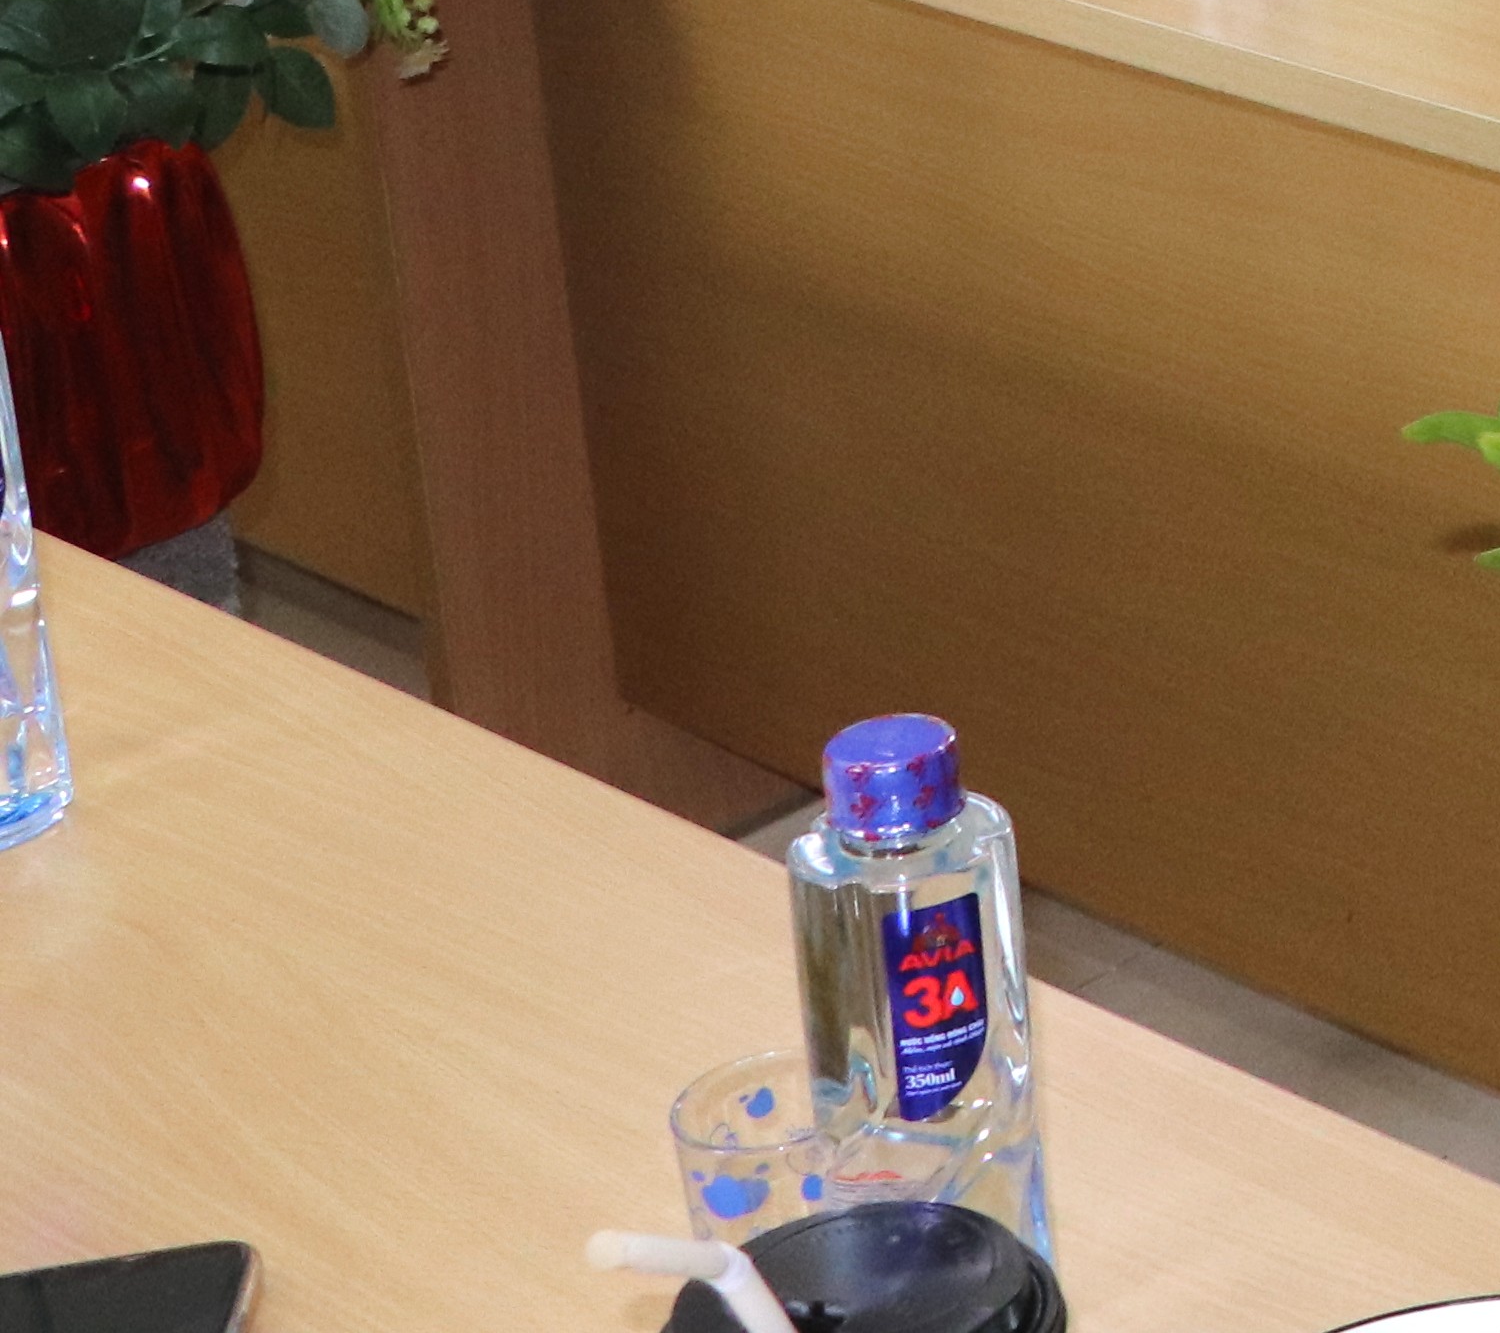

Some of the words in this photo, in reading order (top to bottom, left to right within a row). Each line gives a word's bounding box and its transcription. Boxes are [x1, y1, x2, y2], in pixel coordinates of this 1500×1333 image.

[899, 939, 976, 972] AVIA
[903, 969, 979, 1030] 3A
[905, 1067, 956, 1090] 350ml
